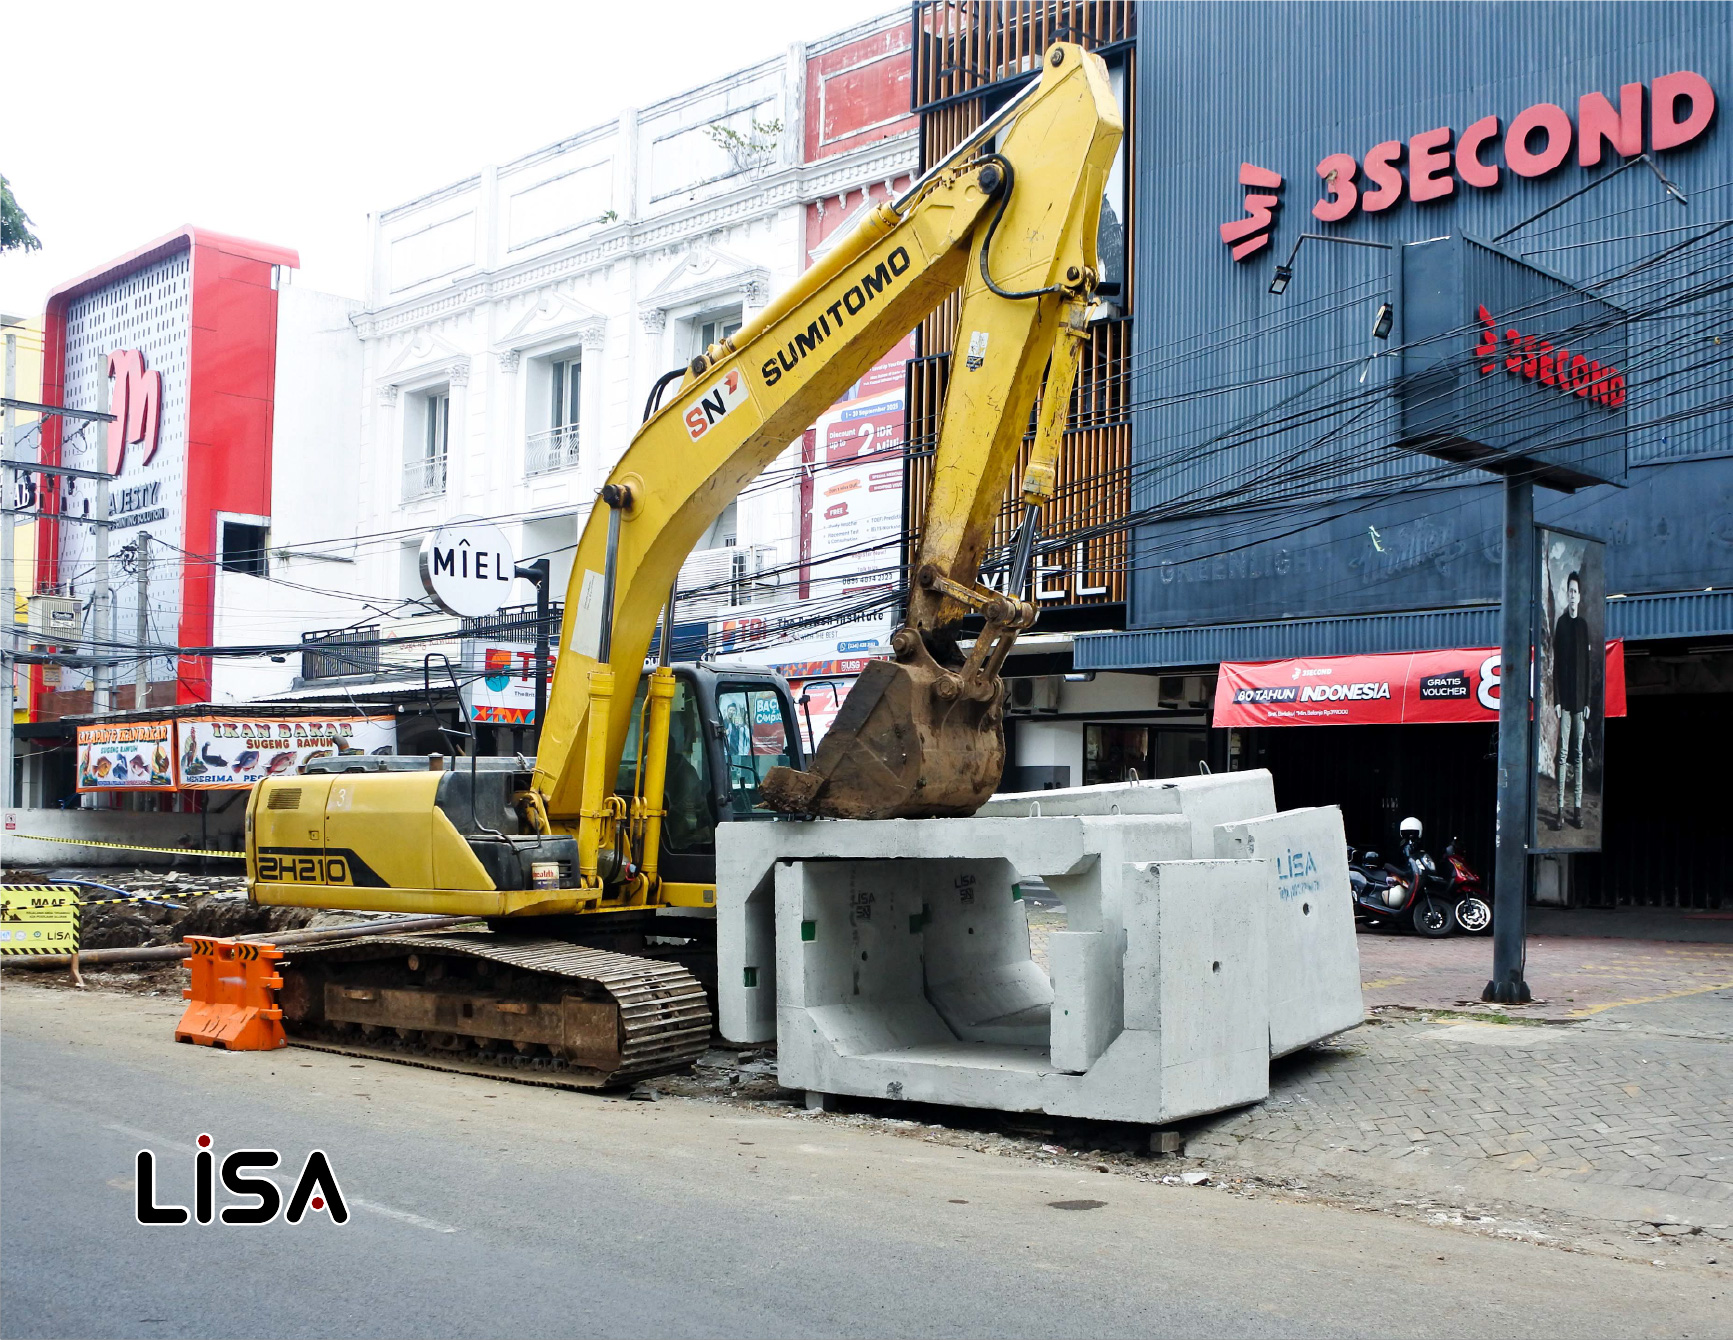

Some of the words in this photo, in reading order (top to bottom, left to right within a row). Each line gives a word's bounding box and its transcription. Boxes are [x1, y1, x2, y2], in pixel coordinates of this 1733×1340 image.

[1312, 70, 1715, 222] 3SECOND
[762, 246, 911, 387] SUMITOMO
[1505, 329, 1626, 408] 3SECOND
[685, 389, 726, 439] SN
[859, 406, 887, 415] September
[829, 428, 856, 439] Discount
[877, 424, 893, 437] IDR
[857, 422, 876, 457] 2
[829, 507, 844, 516] FREE
[1427, 677, 1462, 687] GRATIS
[1238, 691, 1254, 702] 80
[1255, 688, 1295, 702] TAHUN
[1300, 682, 1391, 703] INDONESIA
[1422, 686, 1467, 697] VOUCHER
[211, 723, 270, 738] IKAN
[278, 722, 354, 738] BAKAR
[246, 739, 290, 749] SUGENG
